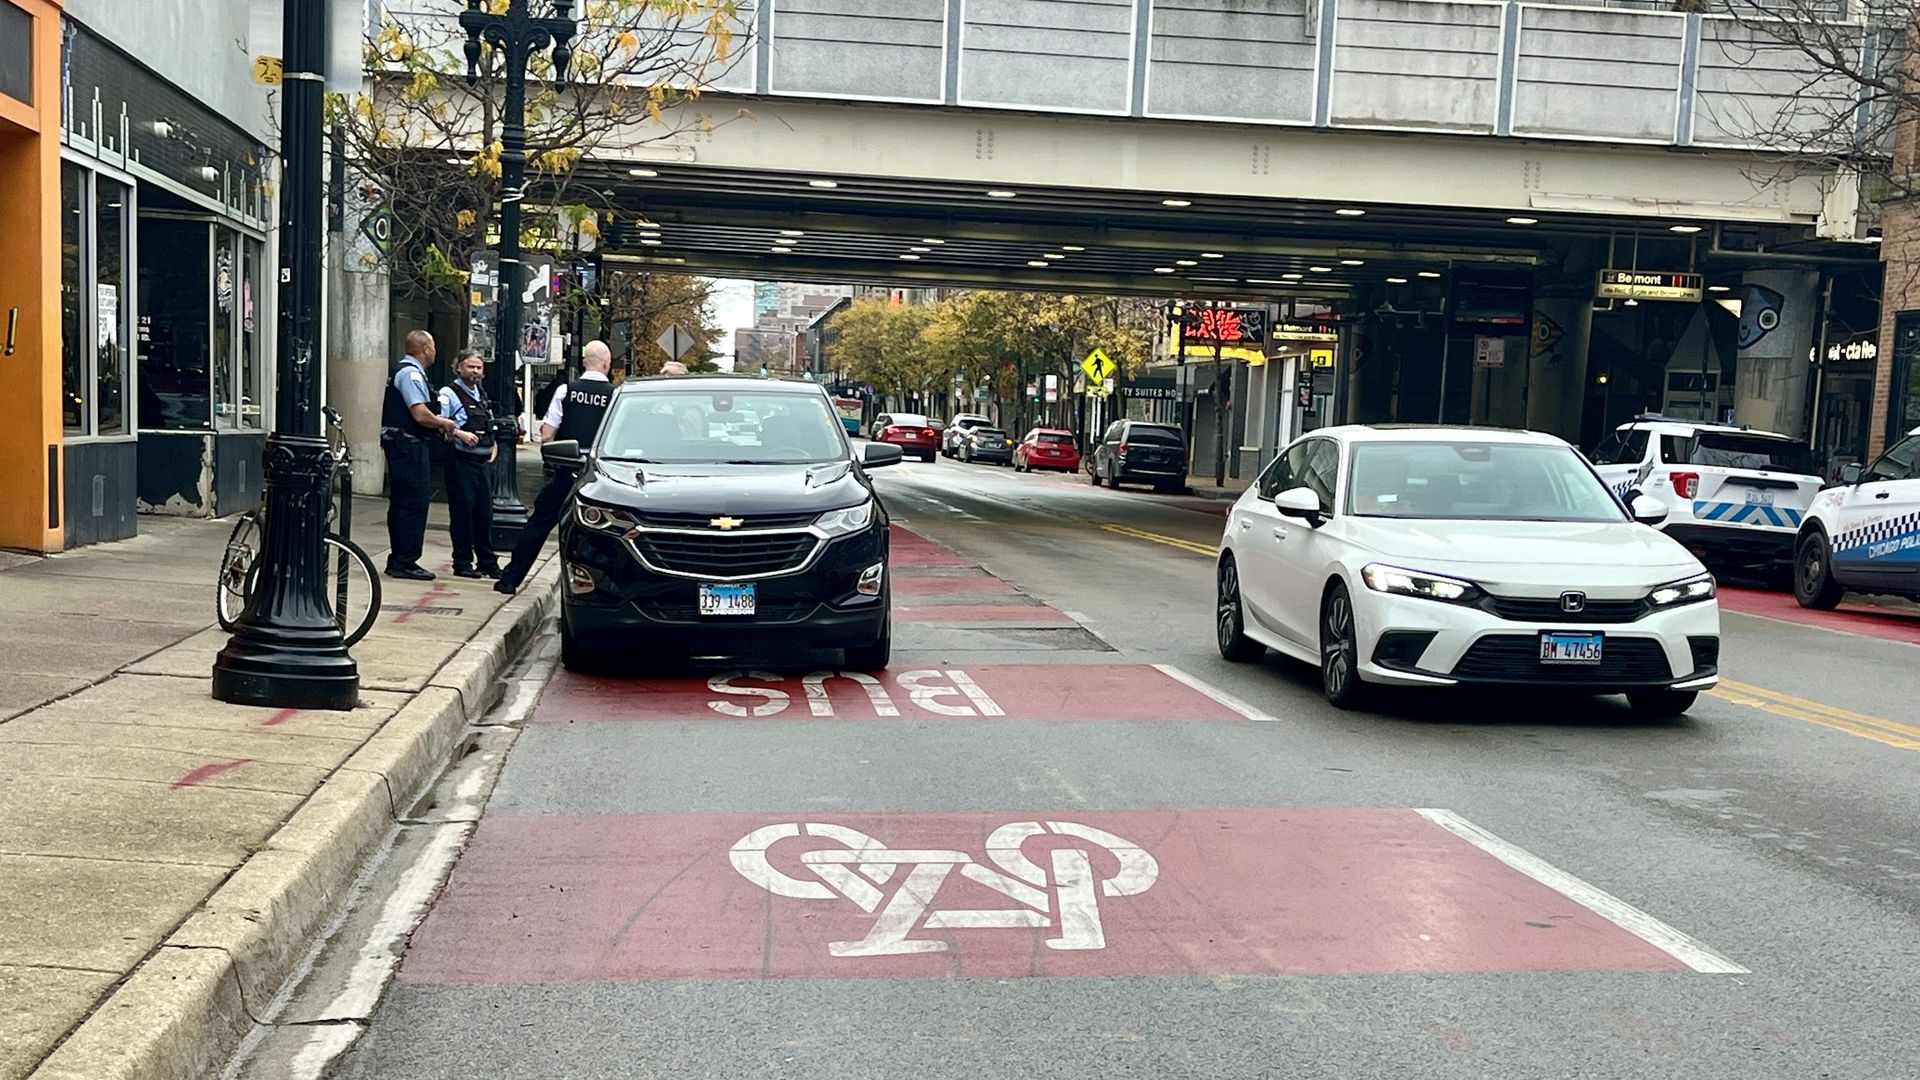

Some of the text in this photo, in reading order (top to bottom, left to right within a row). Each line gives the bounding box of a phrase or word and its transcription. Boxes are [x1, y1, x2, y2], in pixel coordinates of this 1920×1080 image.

[1617, 272, 1661, 285] Bemont
[570, 390, 608, 407] POLICE
[1135, 388, 1163, 397] SUITES
[1165, 389, 1177, 397] HO
[1868, 539, 1900, 559] CHICAGO
[701, 594, 755, 608] 339 1488
[1543, 641, 1600, 658] BM 47456
[707, 669, 1006, 717] BUS
